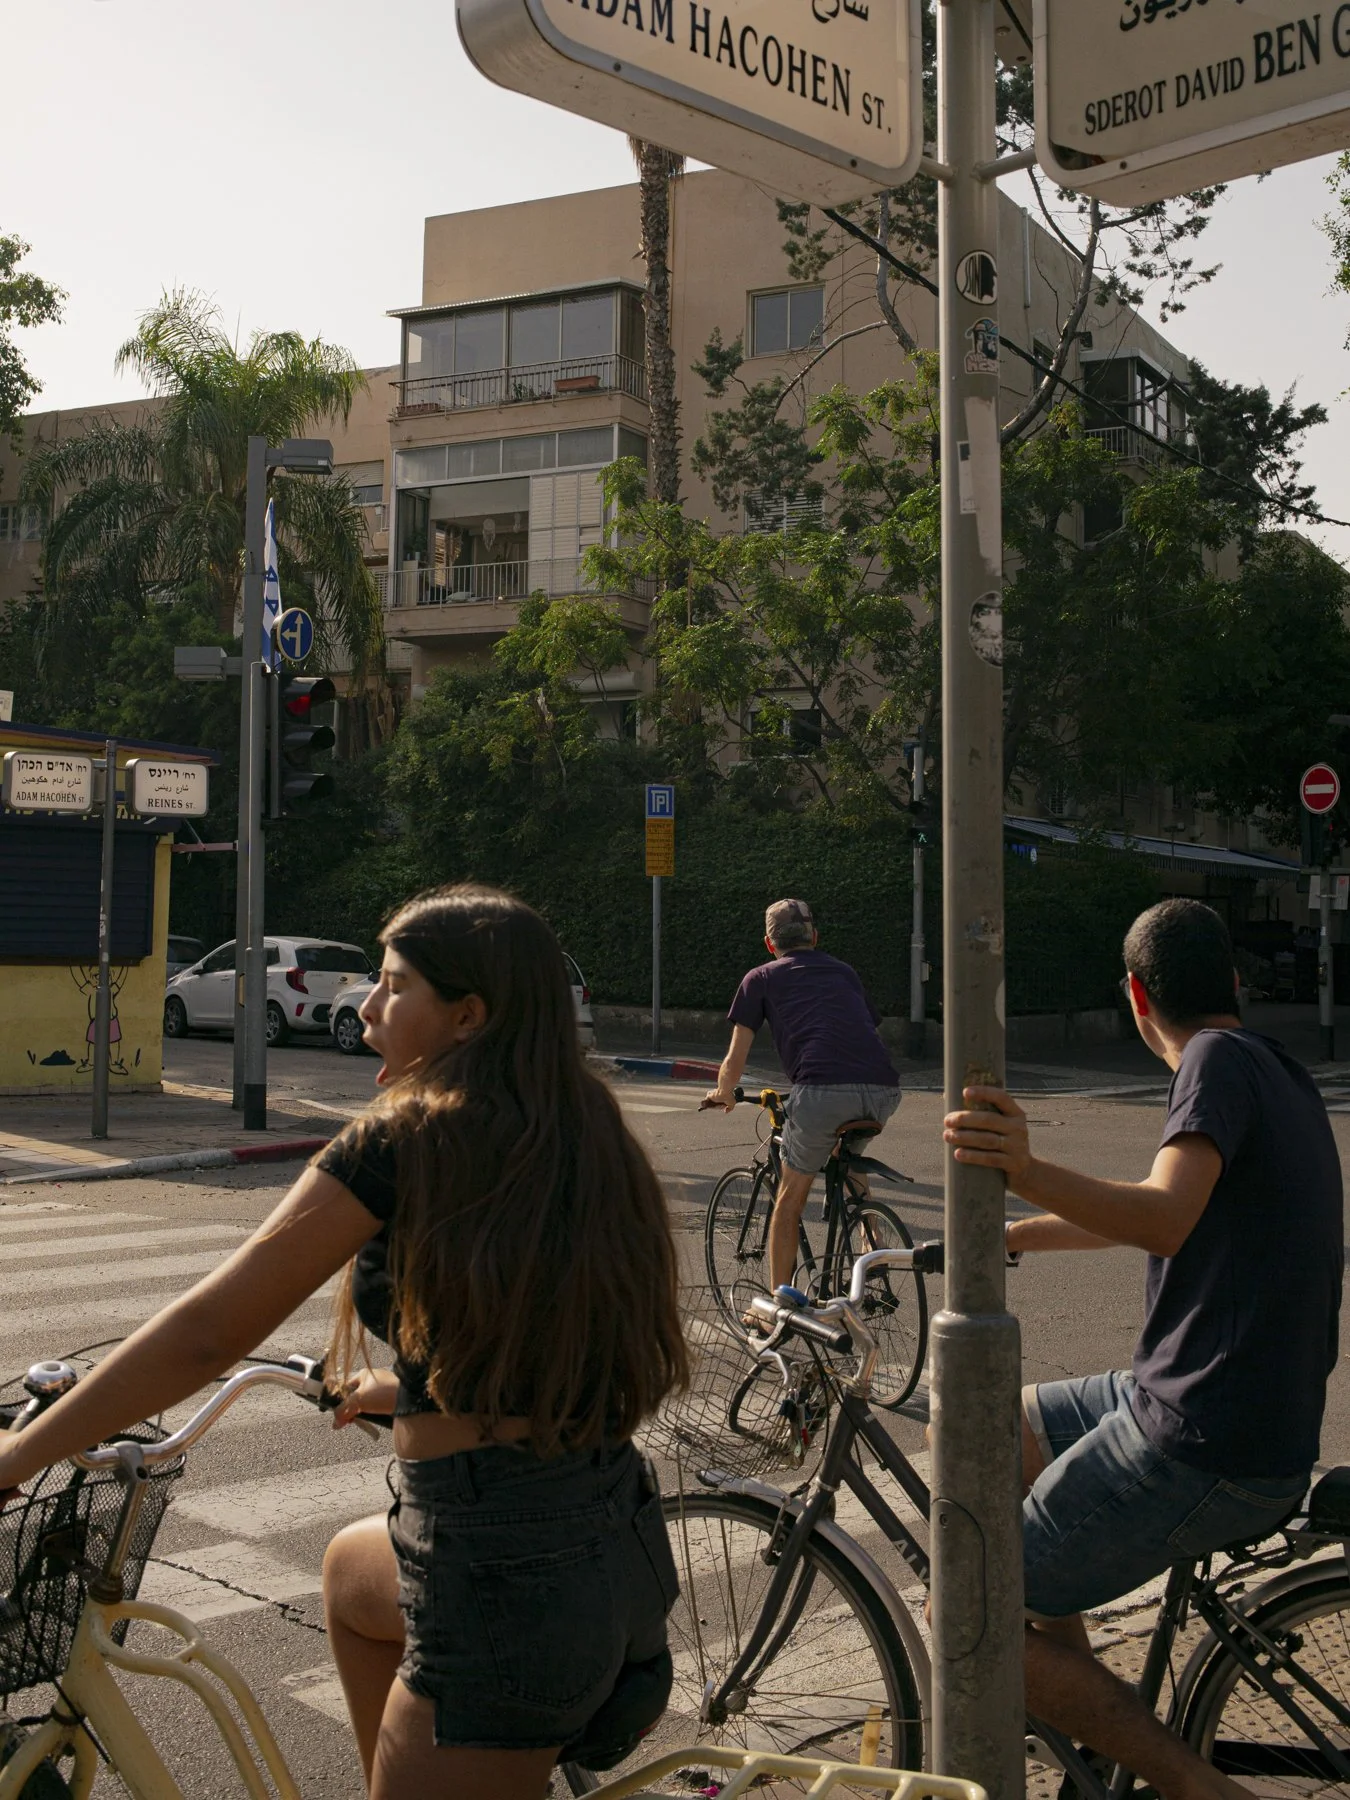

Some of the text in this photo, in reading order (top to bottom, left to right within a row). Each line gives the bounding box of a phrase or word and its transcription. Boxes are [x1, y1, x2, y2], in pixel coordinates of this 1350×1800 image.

[689, 2, 852, 117] HACOHEN
[862, 92, 892, 134] ST.
[1085, 80, 1166, 135] SDEROT
[1175, 57, 1245, 108] DAVID
[1253, 14, 1321, 84] BEN
[17, 759, 43, 773] הכהן
[148, 768, 179, 779] ריינס
[67, 778, 82, 788] شارع
[176, 785, 189, 795] شارع
[16, 791, 38, 801] ADAM
[40, 792, 77, 803] HACOHEN
[147, 798, 183, 809] REINES
